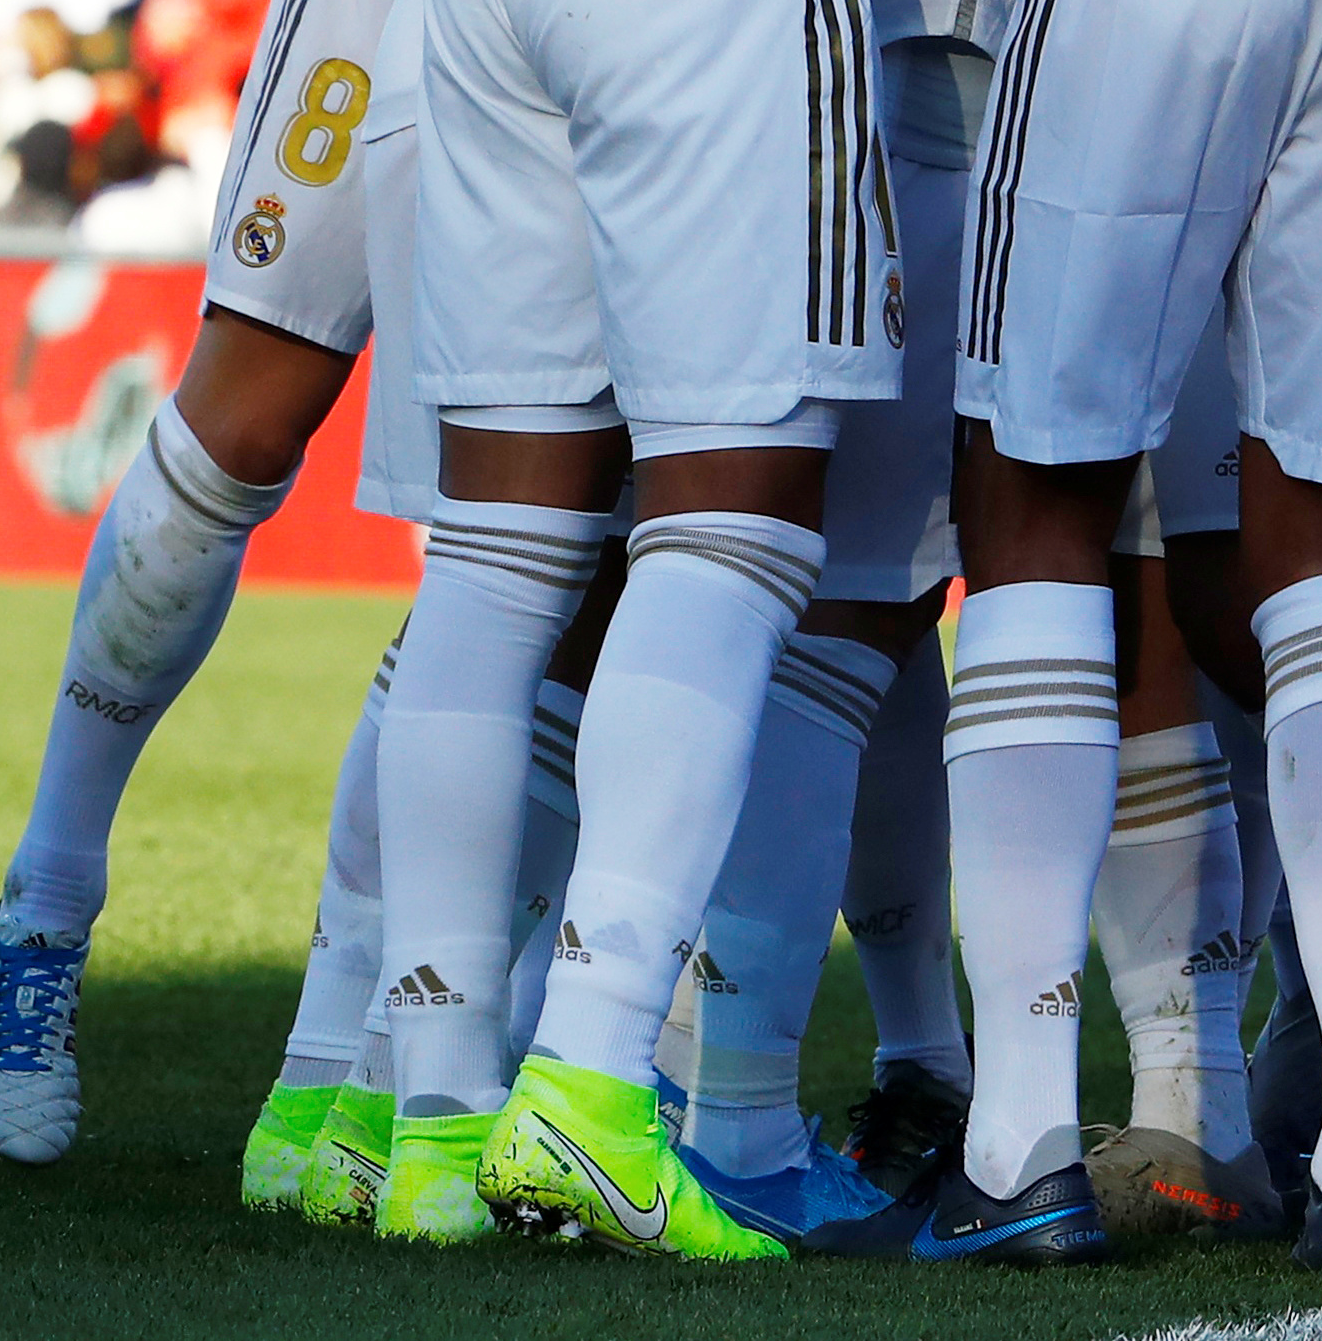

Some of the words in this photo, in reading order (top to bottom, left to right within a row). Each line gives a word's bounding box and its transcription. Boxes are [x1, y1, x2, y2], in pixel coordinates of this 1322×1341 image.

[276, 57, 371, 187] 8
[384, 992, 465, 1009] adidas
[1030, 1001, 1081, 1017] adid
[349, 1169, 379, 1198] CARVA
